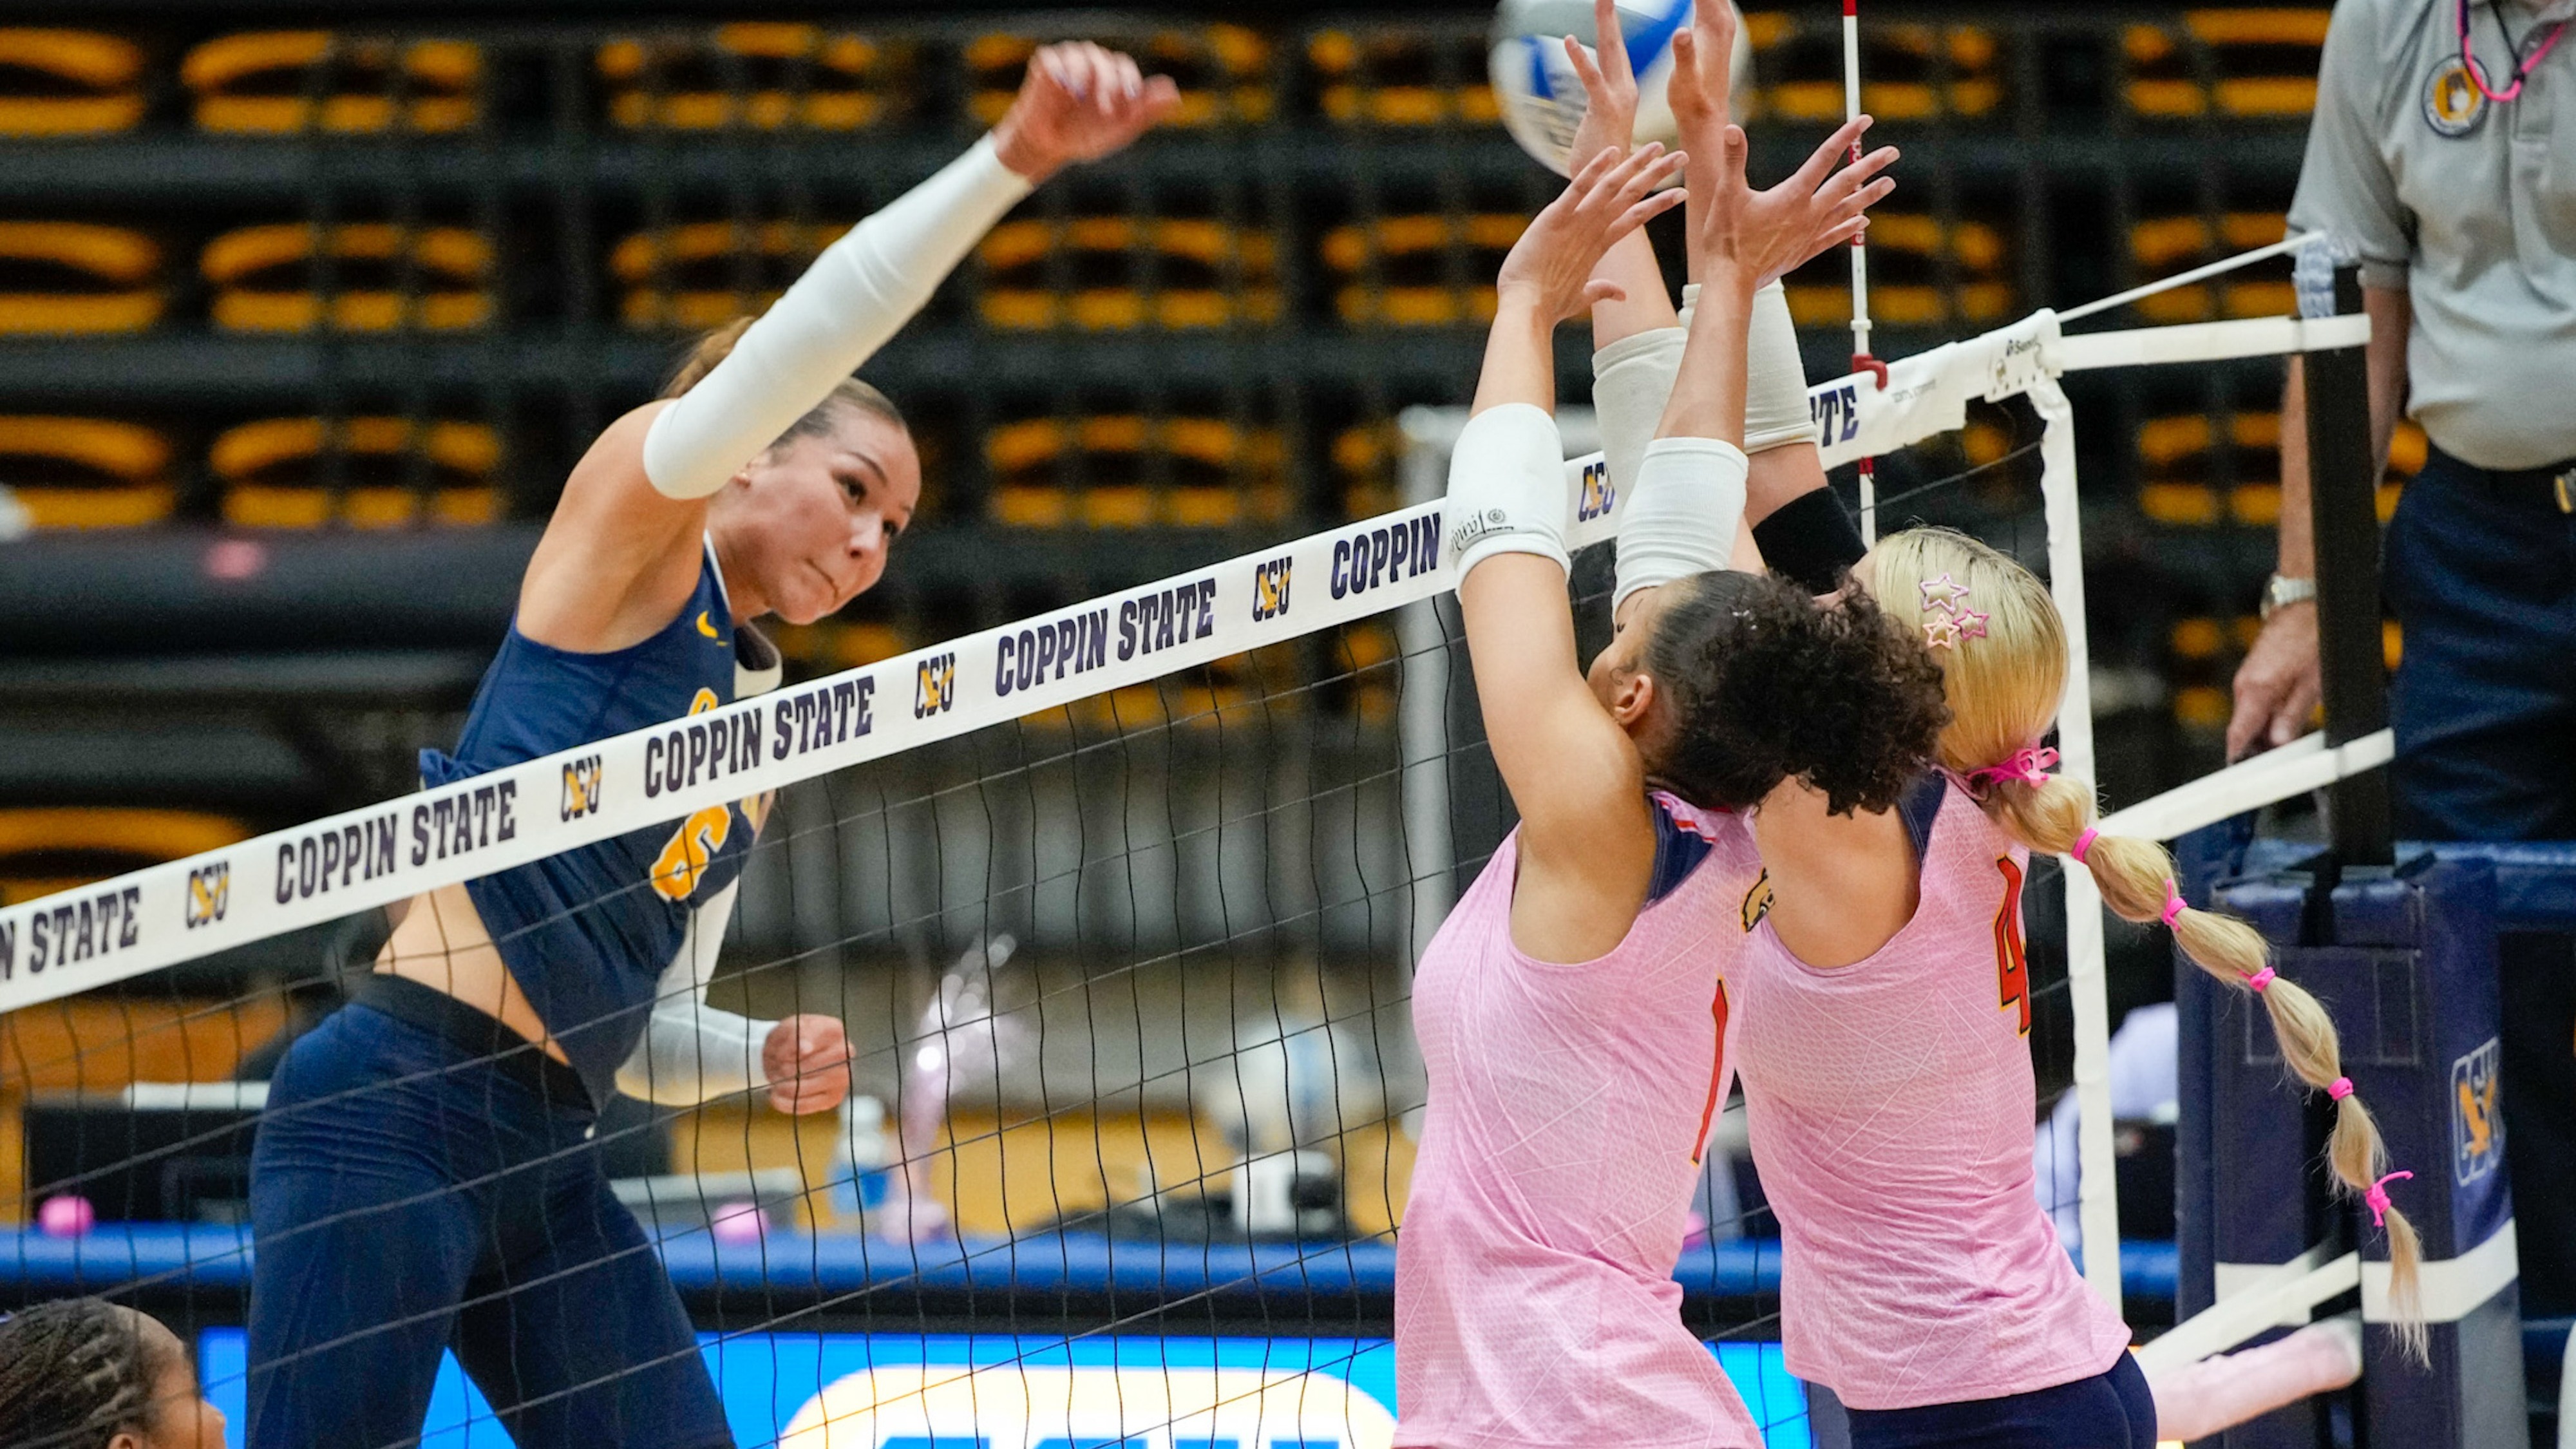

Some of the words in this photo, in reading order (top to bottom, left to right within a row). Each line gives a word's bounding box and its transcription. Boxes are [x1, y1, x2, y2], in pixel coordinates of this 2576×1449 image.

[1811, 384, 1860, 448] TE
[1253, 556, 1292, 622] CSU
[1331, 512, 1441, 600] COPPIN
[996, 608, 1108, 697] COPPIN
[1117, 578, 1216, 661] STATE
[914, 652, 955, 719] CSU
[645, 708, 762, 798] COPPIN
[773, 676, 875, 761] STATE
[561, 754, 601, 822] CSU
[276, 813, 397, 905] COPPIN
[412, 779, 516, 867] STATE
[29, 886, 140, 974] STATE
[186, 861, 229, 929] CSU
[1993, 853, 2032, 1038] 4
[1690, 974, 1730, 1167] 1
